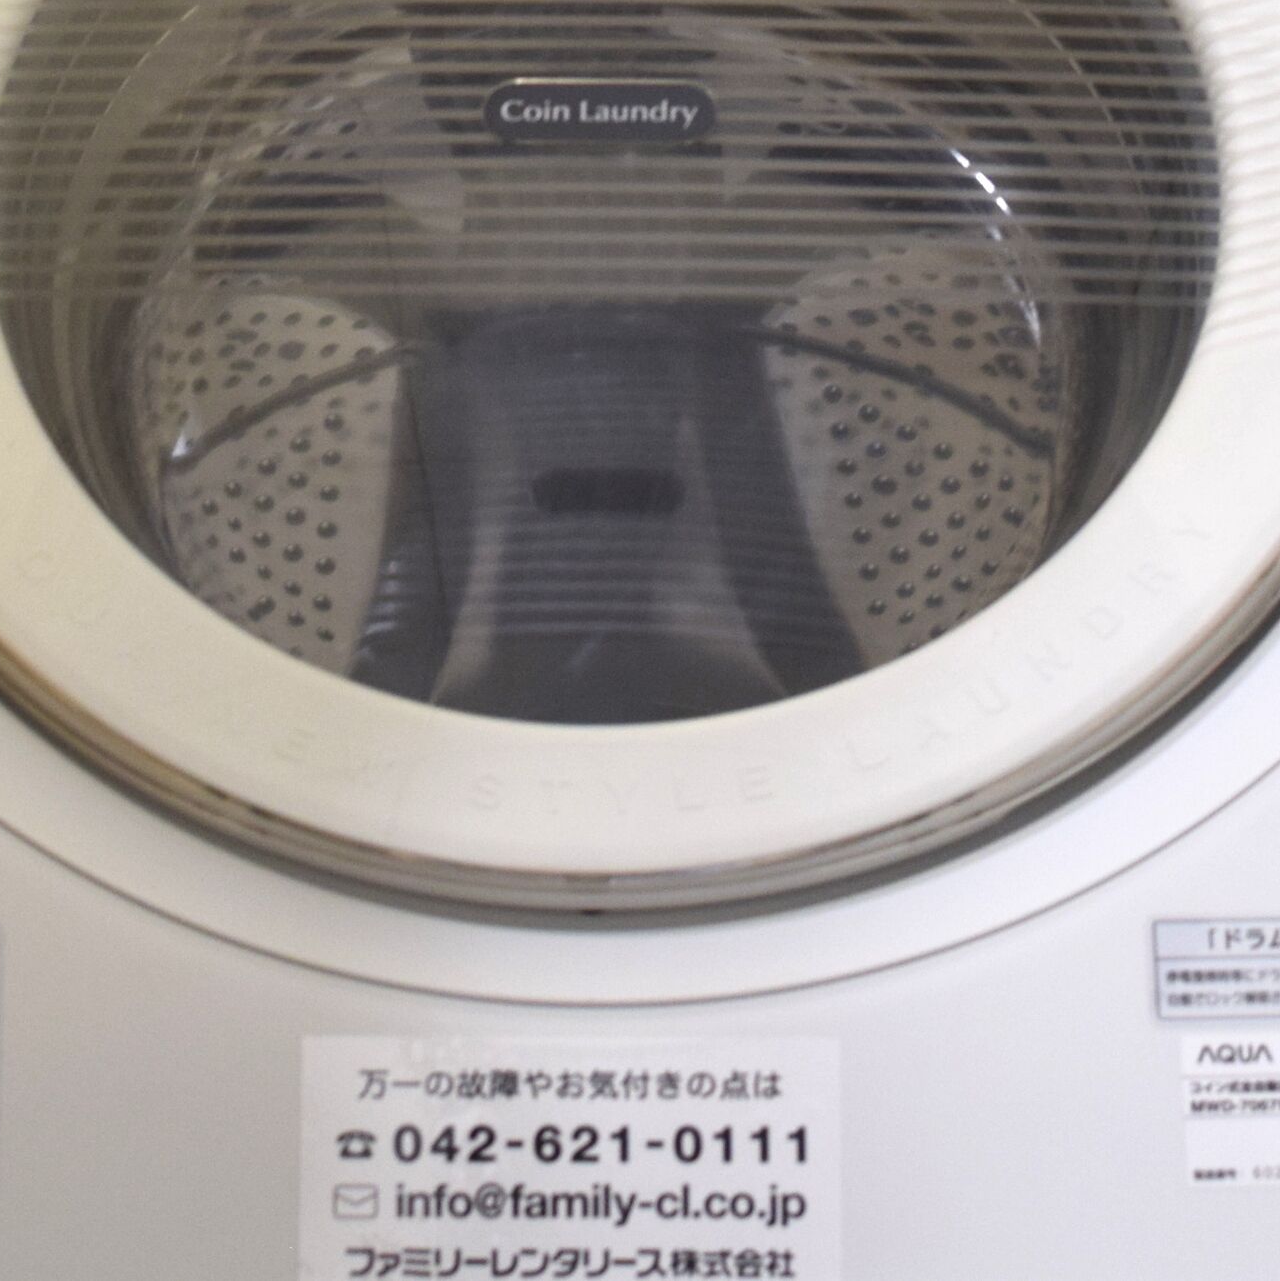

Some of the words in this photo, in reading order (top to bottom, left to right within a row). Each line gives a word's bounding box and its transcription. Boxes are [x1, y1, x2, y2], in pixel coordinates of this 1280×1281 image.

[500, 99, 570, 123] Coin
[579, 99, 699, 130] Laundry
[357, 1068, 782, 1101] 万一の故障やお気付きの点は
[391, 1124, 810, 1165] 042-621-0111
[393, 1182, 808, 1226] info@family-cl.co.jp
[345, 1248, 795, 1280] ファミリーレンタリース株式会社
